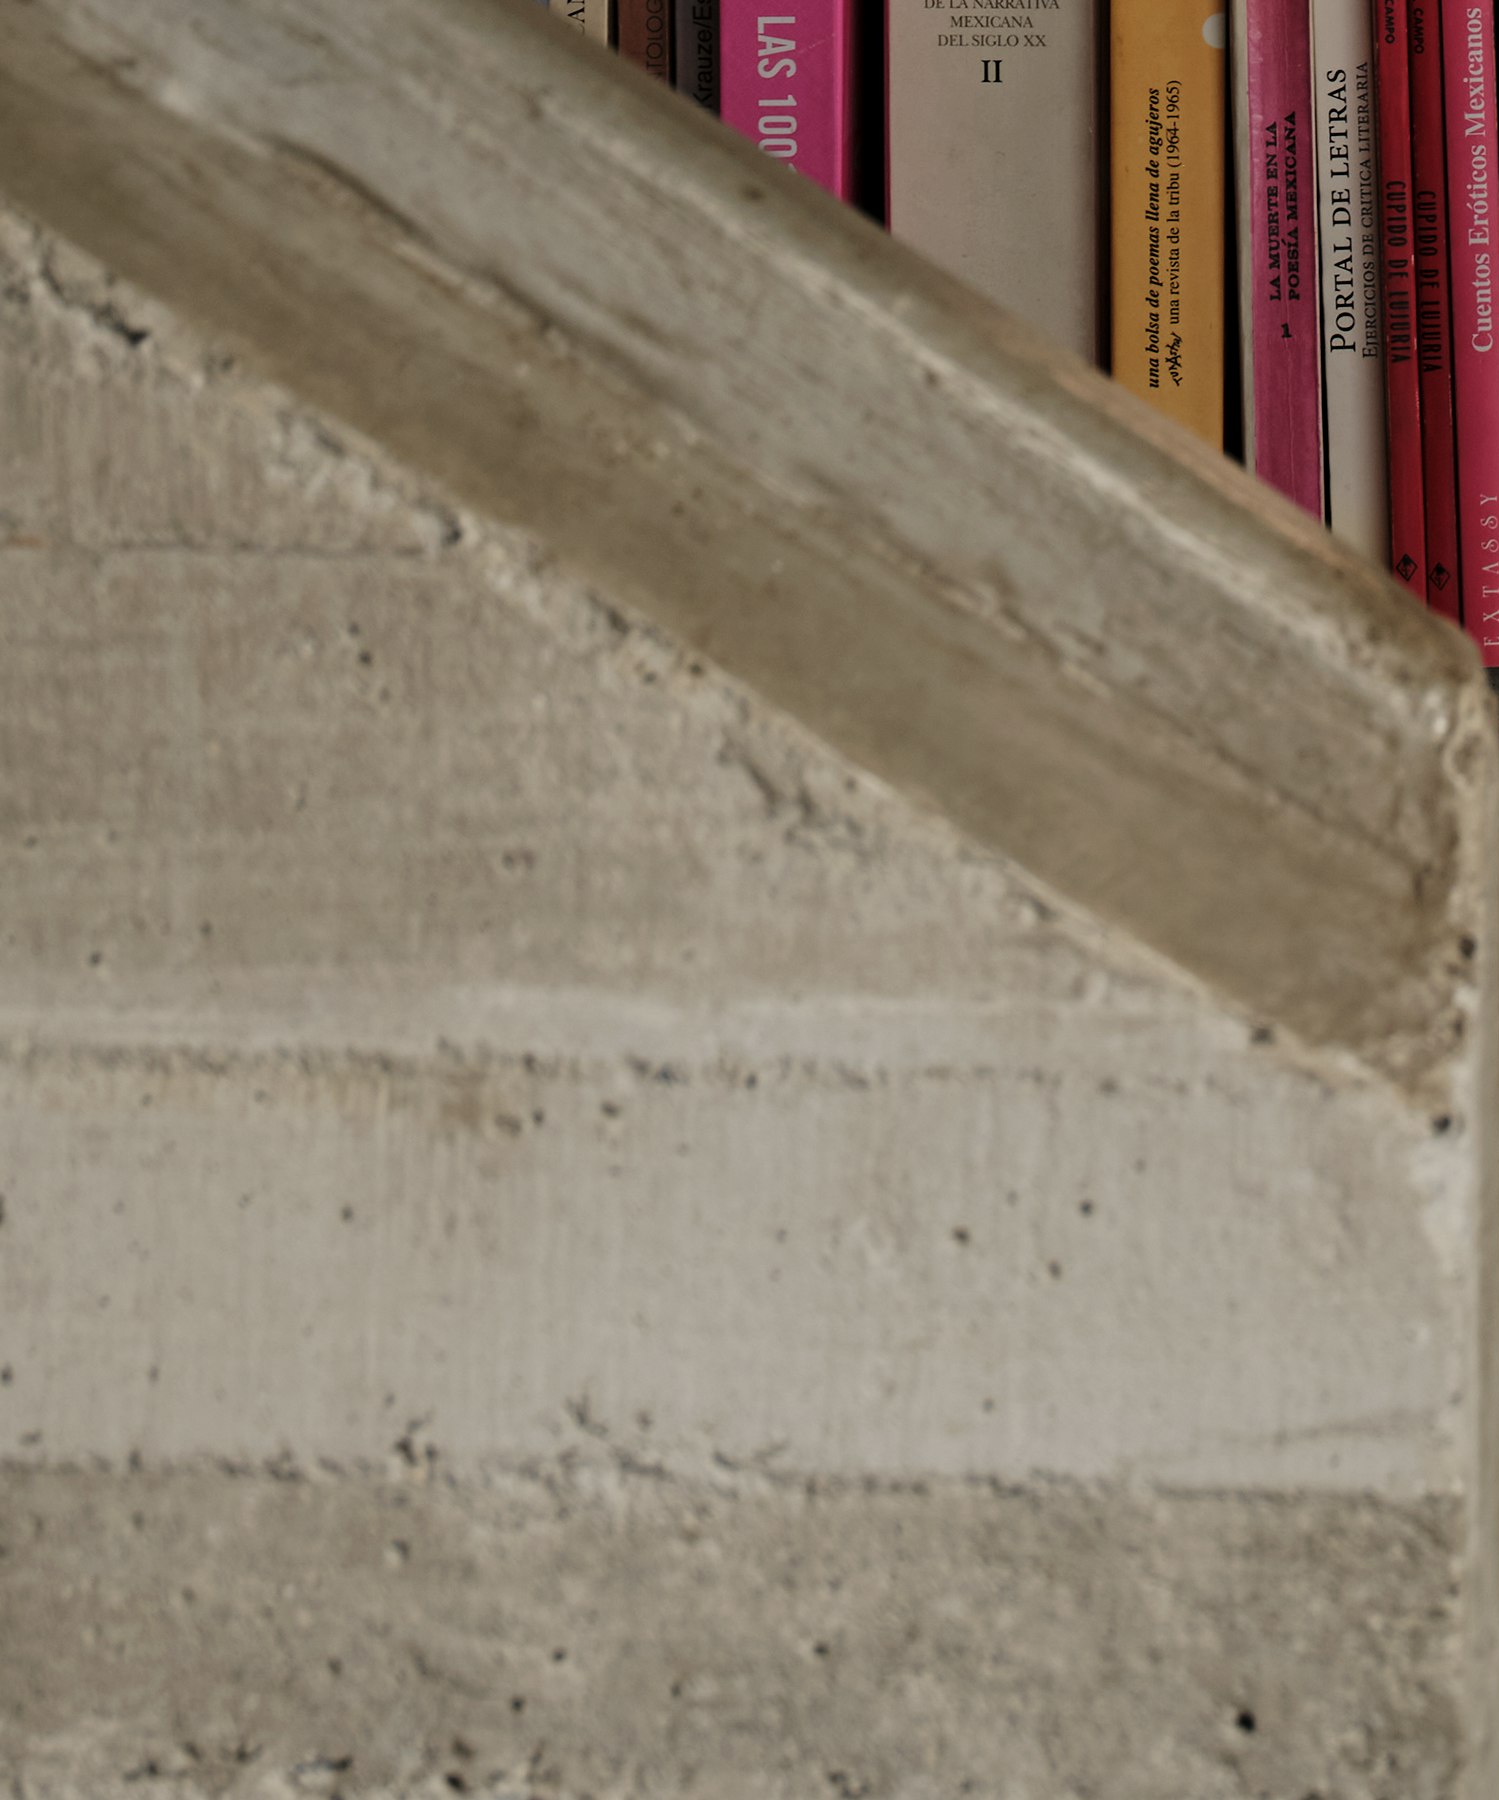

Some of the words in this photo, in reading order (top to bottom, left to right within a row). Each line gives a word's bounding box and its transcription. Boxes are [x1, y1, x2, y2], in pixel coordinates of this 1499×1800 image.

[753, 15, 797, 78] LAS
[1464, 8, 1487, 137] Mexicanos
[1466, 145, 1490, 245] Eróticos
[1471, 253, 1493, 352] Cuentos
